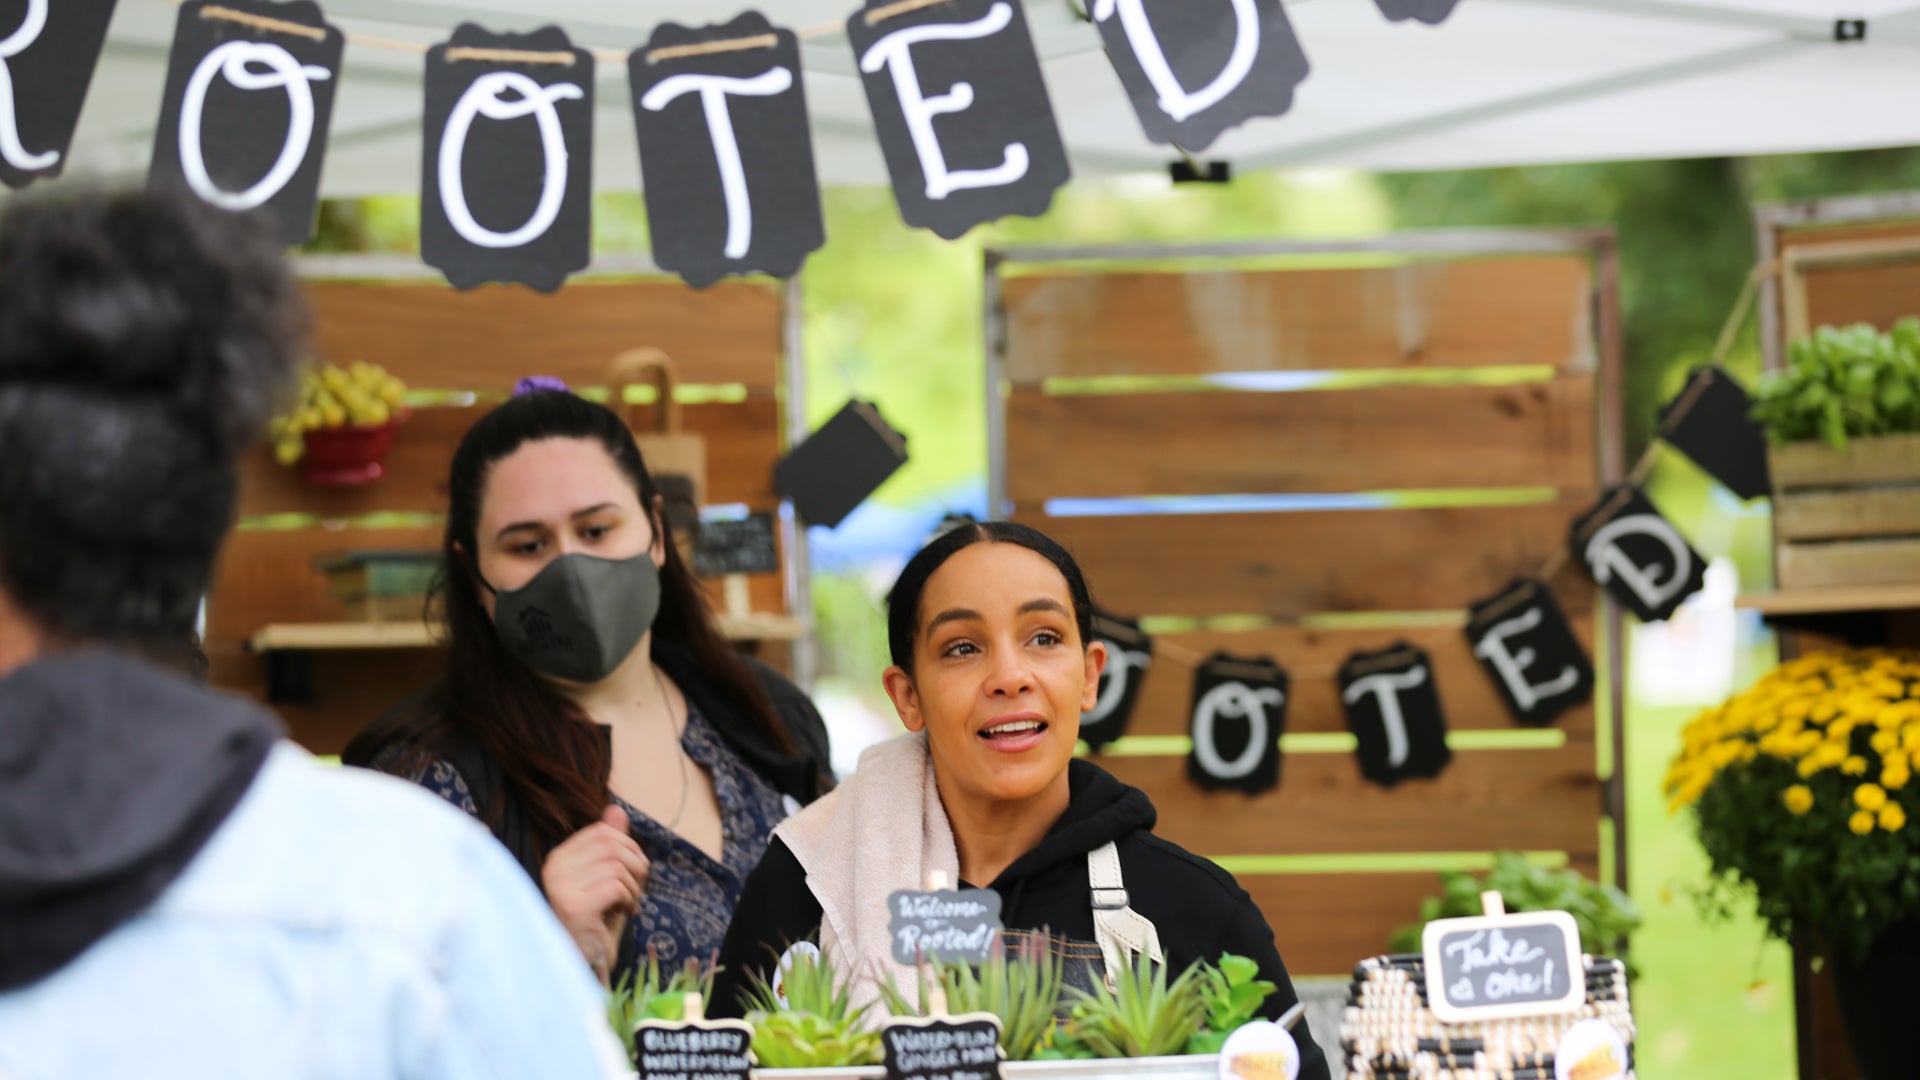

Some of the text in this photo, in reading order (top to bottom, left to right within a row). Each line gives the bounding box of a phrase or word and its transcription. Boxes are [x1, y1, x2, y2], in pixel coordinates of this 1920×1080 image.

[898, 894, 988, 919] Welcome
[896, 923, 996, 957] Rooted!
[1445, 927, 1545, 973] Take
[643, 1028, 742, 1052] BLUEBERRY
[896, 1048, 960, 1073] GINGER
